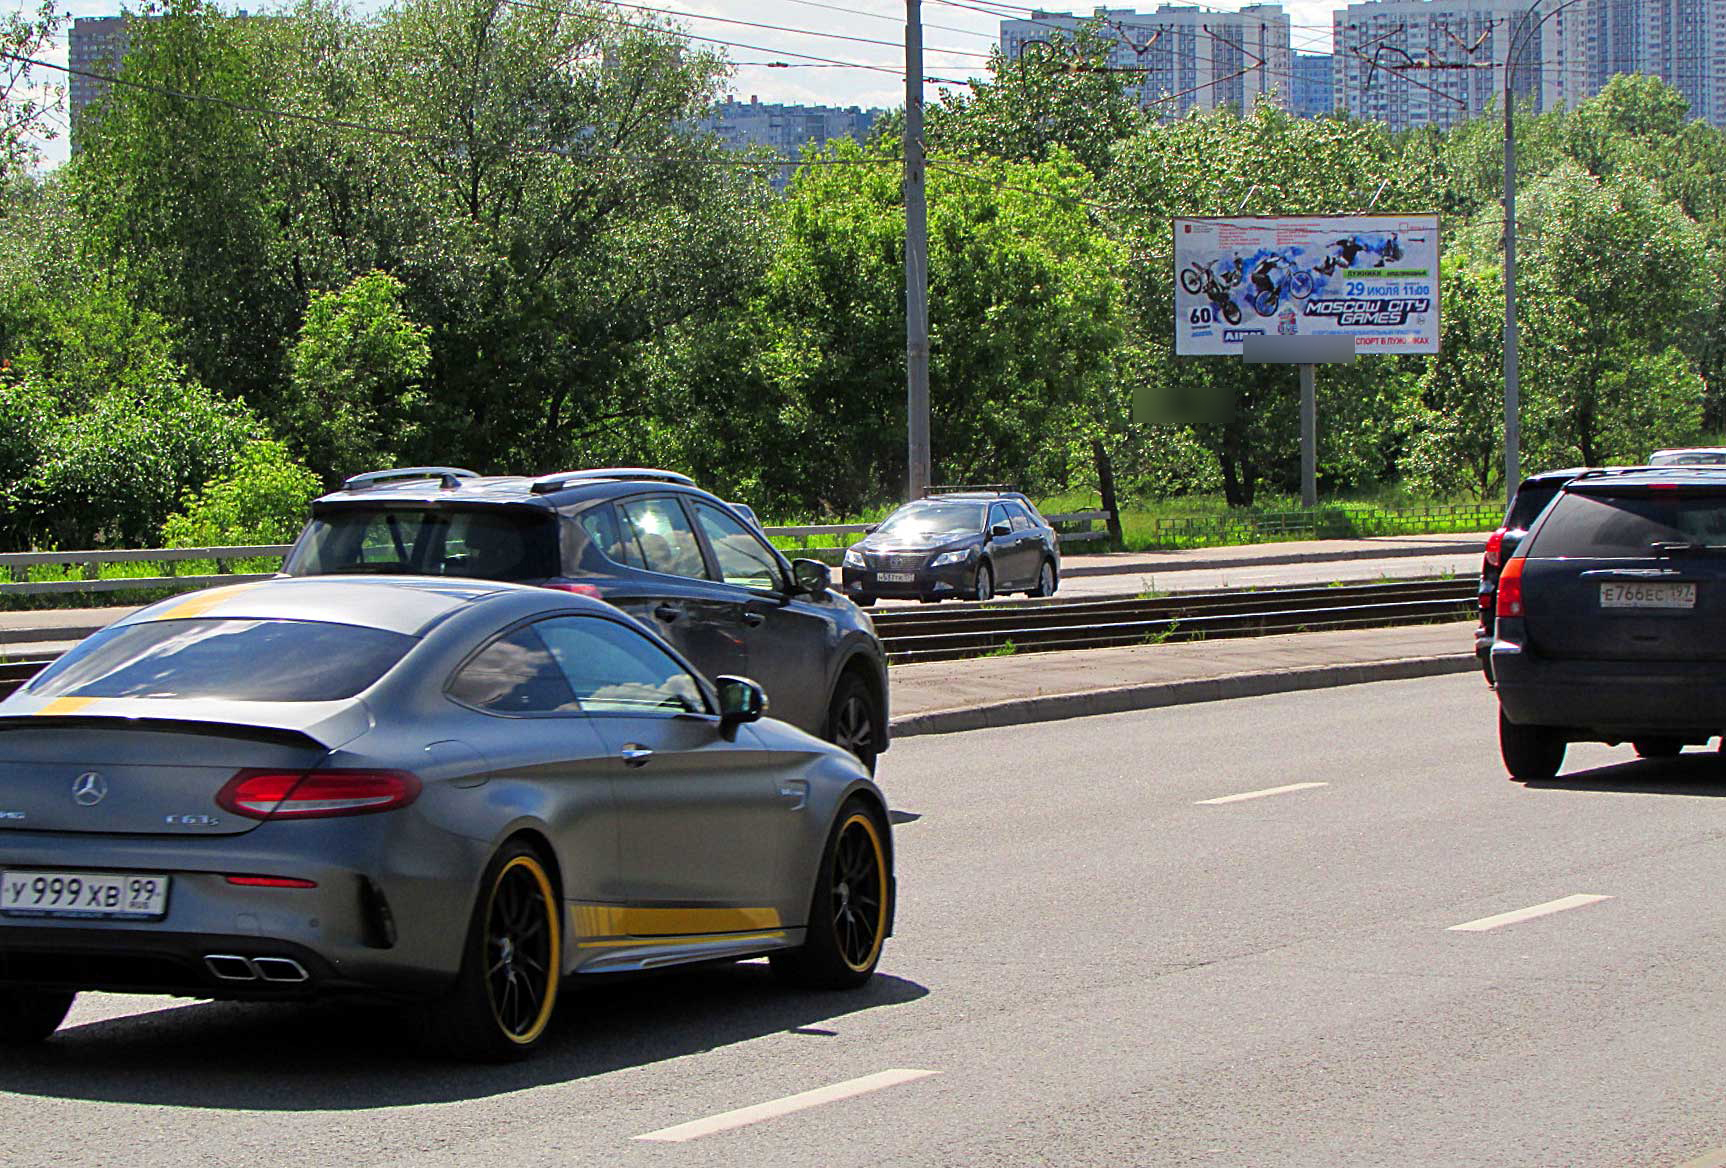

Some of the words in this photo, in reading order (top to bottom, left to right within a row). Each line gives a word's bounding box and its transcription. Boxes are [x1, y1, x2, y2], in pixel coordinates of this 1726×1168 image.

[1346, 282, 1365, 297] 29
[1367, 286, 1399, 296] ИЮЛЯ
[1403, 285, 1430, 296] 11:00
[1305, 301, 1380, 314] MOSCOW
[1388, 300, 1428, 312] CITY
[1190, 307, 1211, 324] 60
[1341, 312, 1402, 325] GAMES
[129, 879, 156, 901] 99
